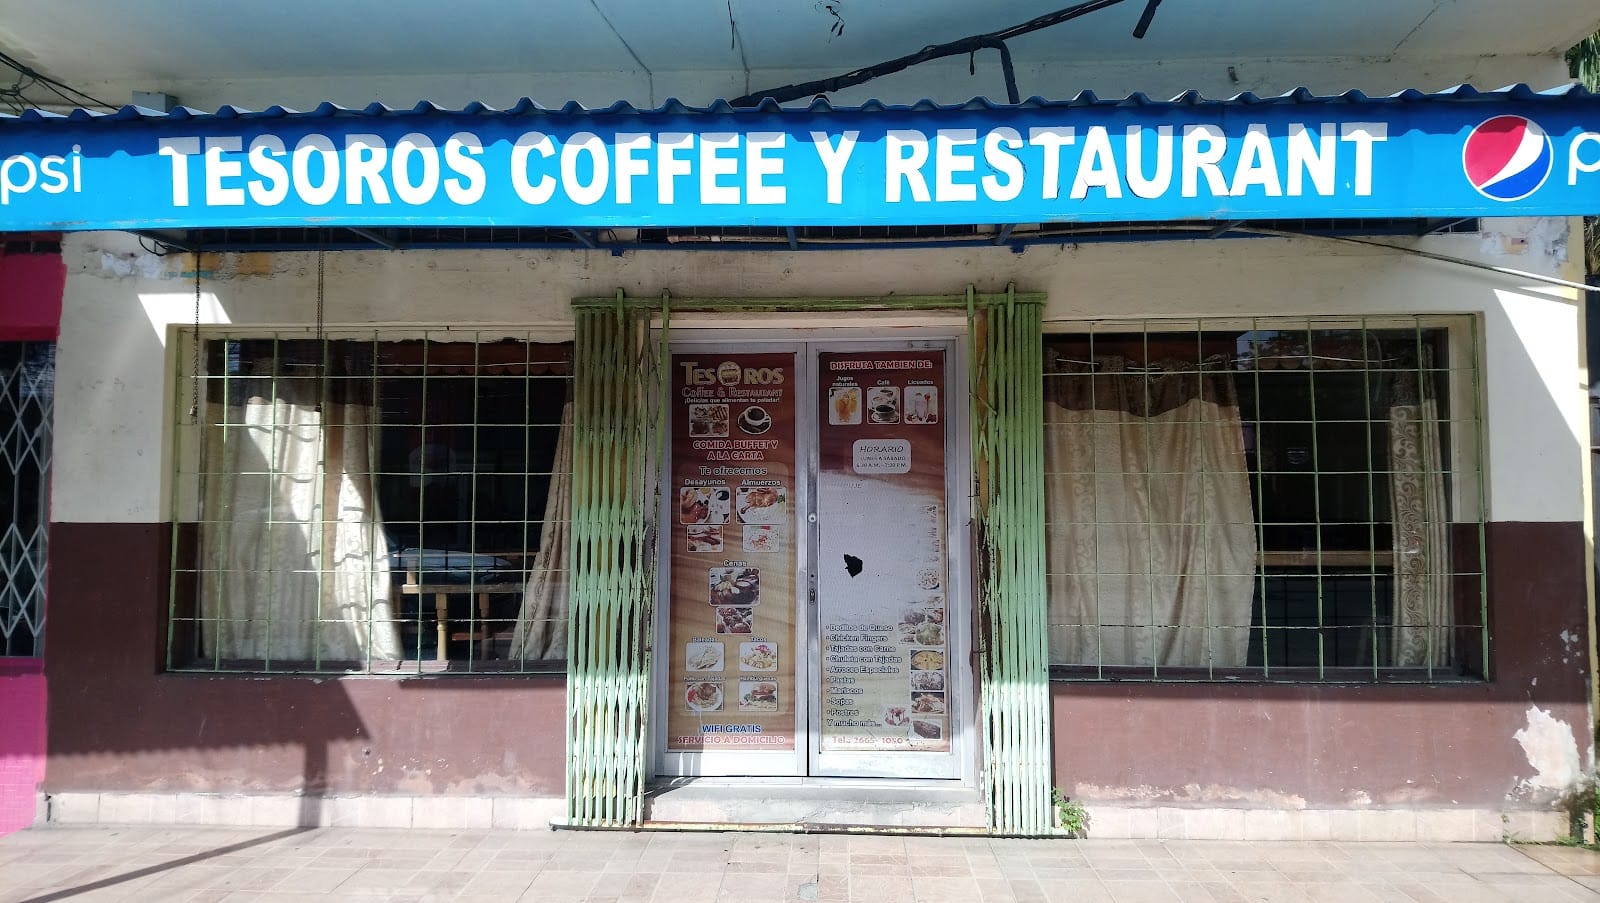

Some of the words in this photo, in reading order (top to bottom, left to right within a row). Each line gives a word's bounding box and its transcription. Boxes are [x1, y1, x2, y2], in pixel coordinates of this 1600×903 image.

[158, 132, 486, 207] TESOROS
[510, 131, 786, 205] COFFEE
[810, 130, 860, 204] Y
[885, 122, 1388, 203] RESTAURANT
[693, 440, 732, 450] COMIDA
[733, 440, 770, 449] BUFFET
[770, 440, 778, 449] Y
[860, 445, 904, 453] HORARIO
[707, 451, 715, 460] A
[716, 451, 731, 460] LA
[731, 451, 764, 460] CARTA
[699, 466, 711, 475] Te
[714, 466, 768, 475] ofrecemos
[684, 479, 726, 487] Desayunos
[830, 645, 858, 653] Tajadas
[874, 655, 902, 664] Tajadas
[830, 665, 859, 673] Arroces
[831, 686, 863, 694] Mariscos
[831, 697, 854, 706] Sopas
[831, 708, 859, 716] Postres
[834, 719, 859, 727] mucho
[702, 725, 723, 733] WIFI
[725, 725, 761, 733] GRATIS
[678, 736, 721, 745] SERVICIO
[724, 736, 731, 744] A
[733, 736, 785, 744] DOMICILIO
